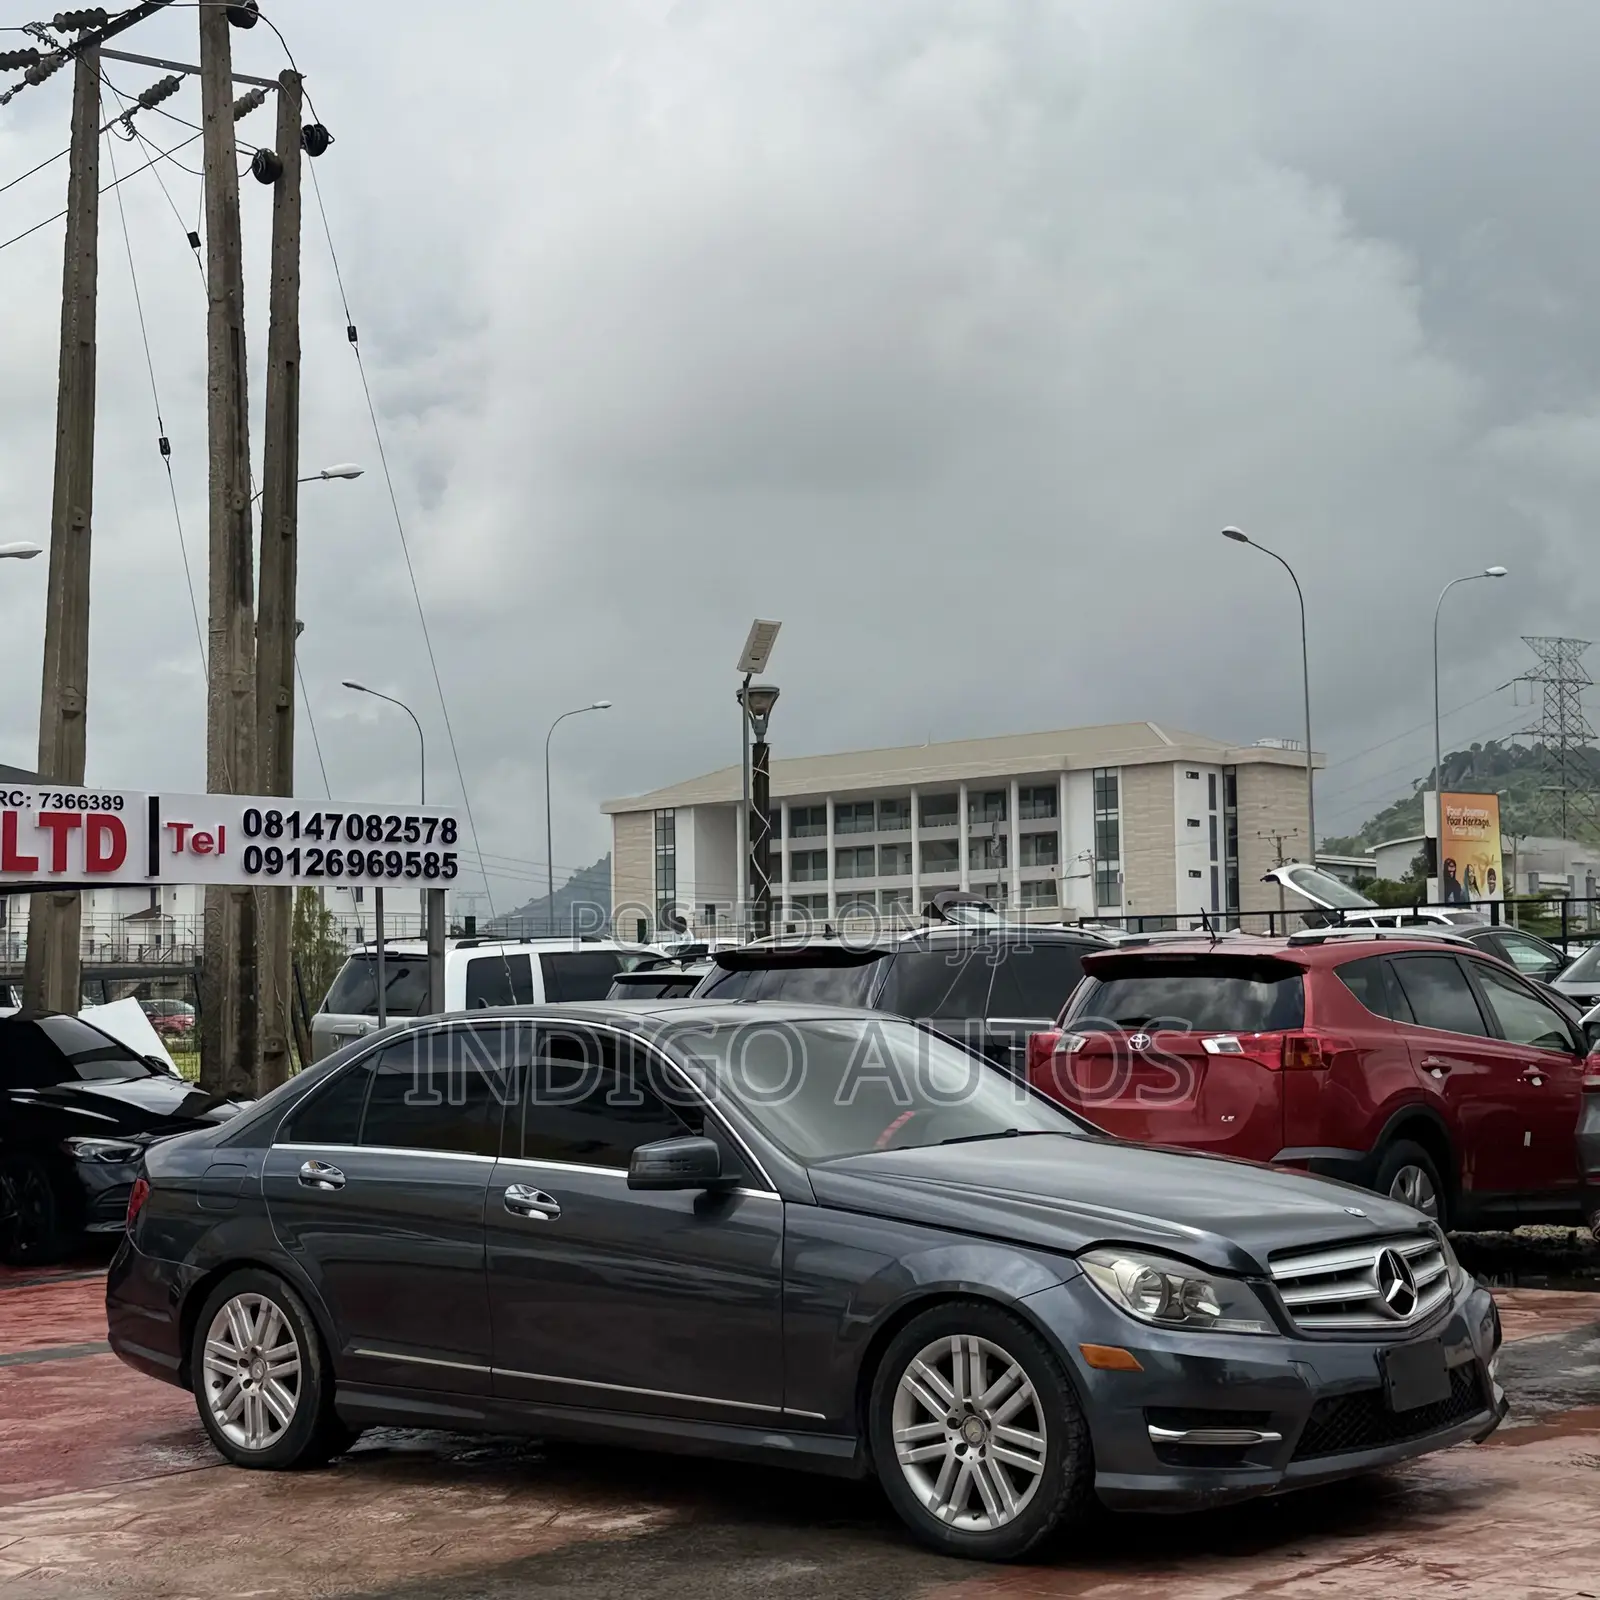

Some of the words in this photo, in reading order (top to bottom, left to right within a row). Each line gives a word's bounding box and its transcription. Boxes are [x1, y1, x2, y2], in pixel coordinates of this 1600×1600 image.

[38, 793, 125, 811] 7366389
[2, 810, 128, 873] LTD
[165, 821, 227, 855] Tel
[242, 808, 458, 845] 08147082578
[243, 845, 459, 880] 09126969585
